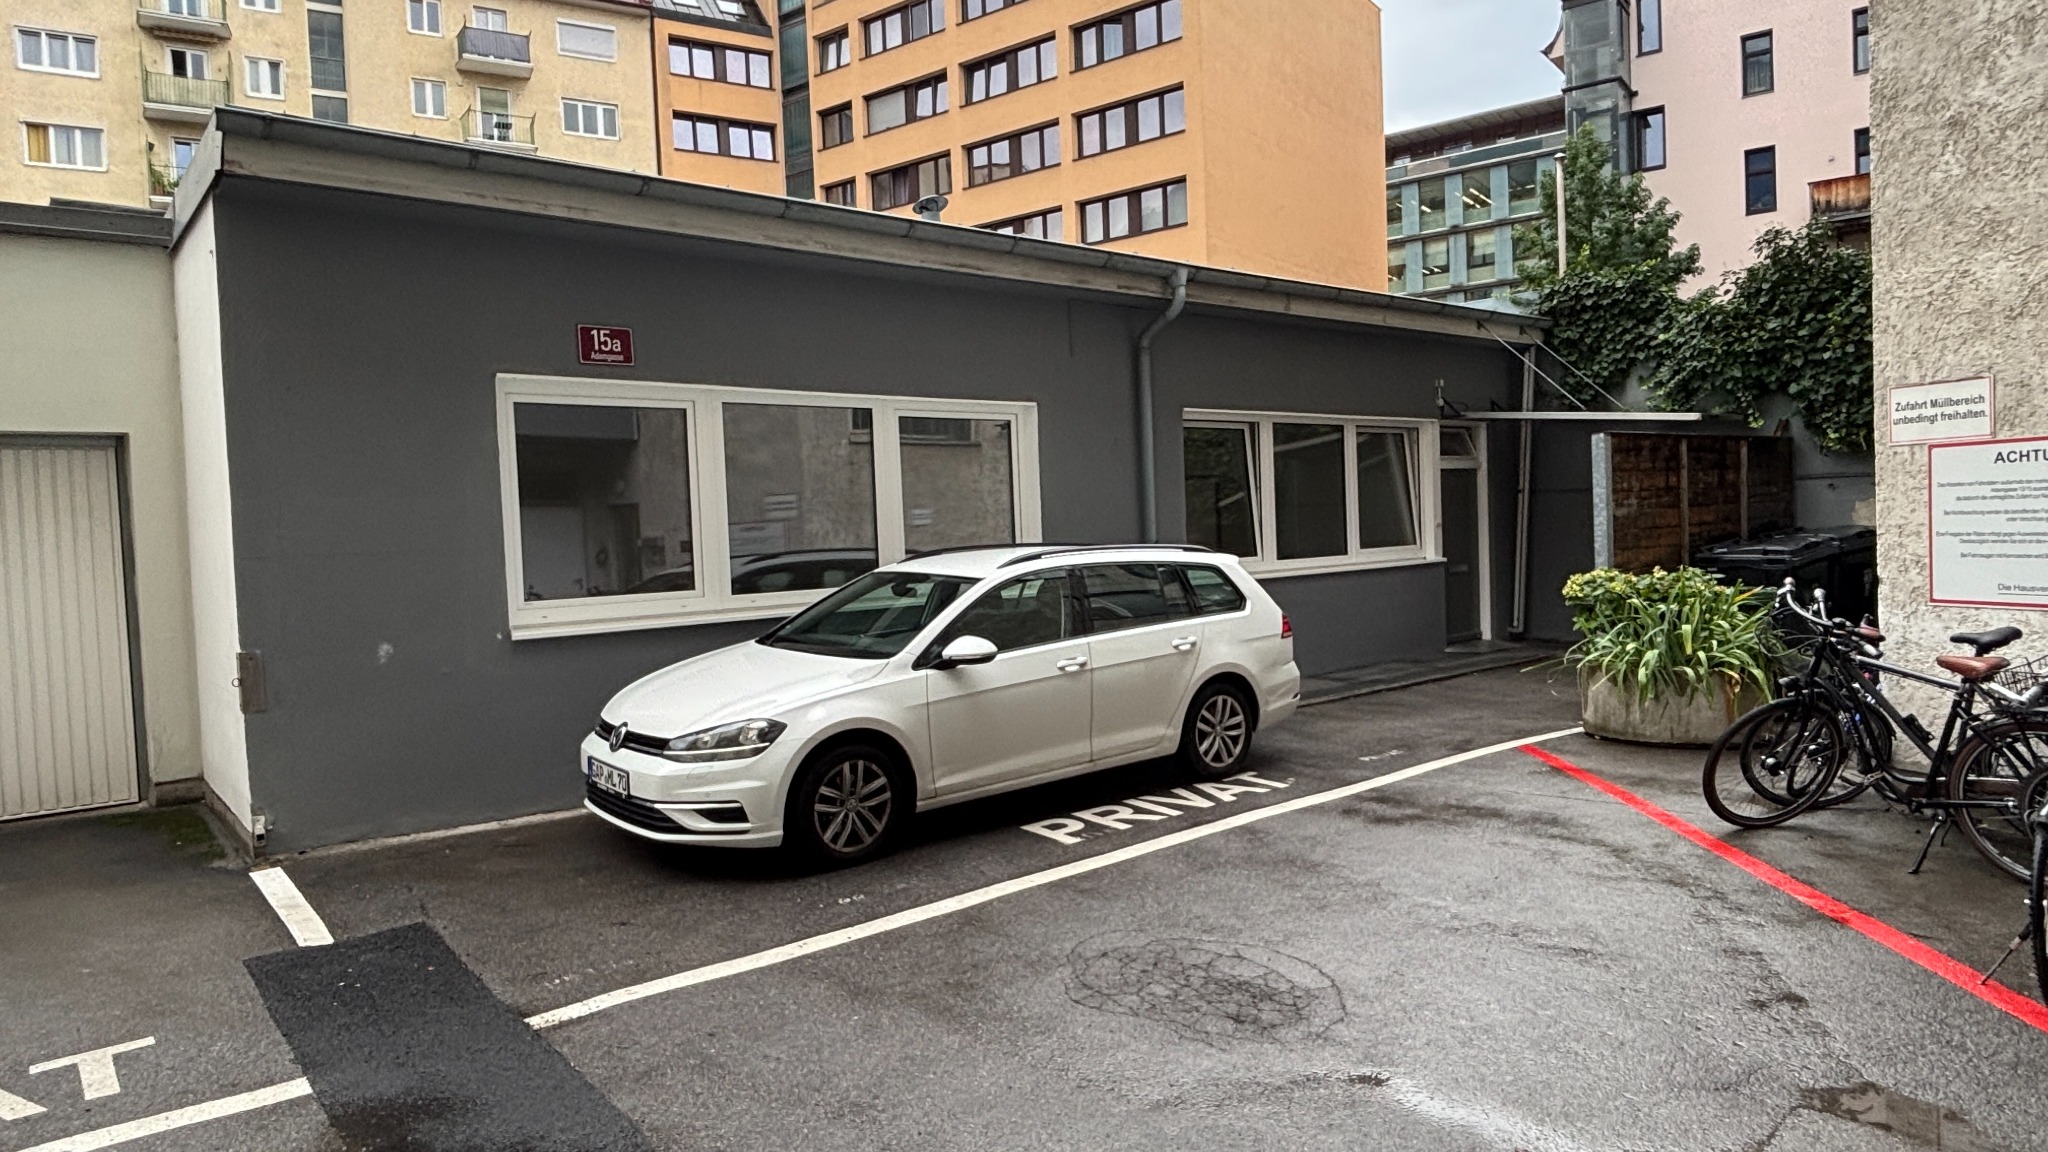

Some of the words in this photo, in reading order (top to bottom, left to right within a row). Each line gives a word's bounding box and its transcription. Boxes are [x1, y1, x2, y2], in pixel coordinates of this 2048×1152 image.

[590, 330, 621, 351] 15a
[1895, 400, 1927, 412] Zufahrt
[1930, 394, 1985, 408] Müllbereich
[1893, 412, 1938, 426] unbedingt
[1940, 408, 1988, 422] freihalten.
[1997, 583, 2012, 591] Die
[1020, 771, 1290, 845] PRIVAT
